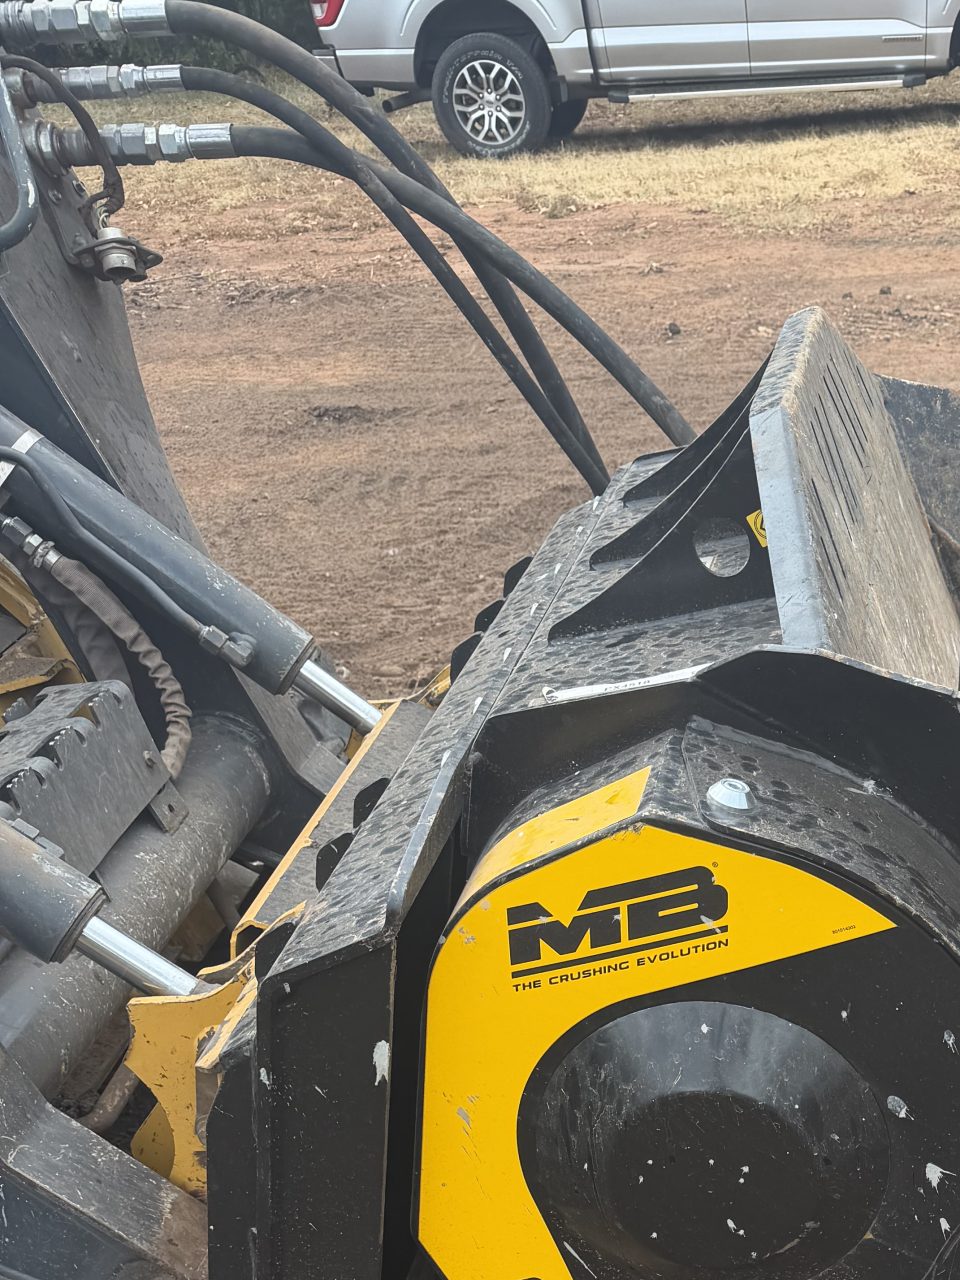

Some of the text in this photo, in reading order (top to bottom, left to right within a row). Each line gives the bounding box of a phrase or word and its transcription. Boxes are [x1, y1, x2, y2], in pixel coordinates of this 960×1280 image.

[506, 865, 729, 966] MB
[512, 938, 729, 992] THE CRUSHING EVOLUTION
